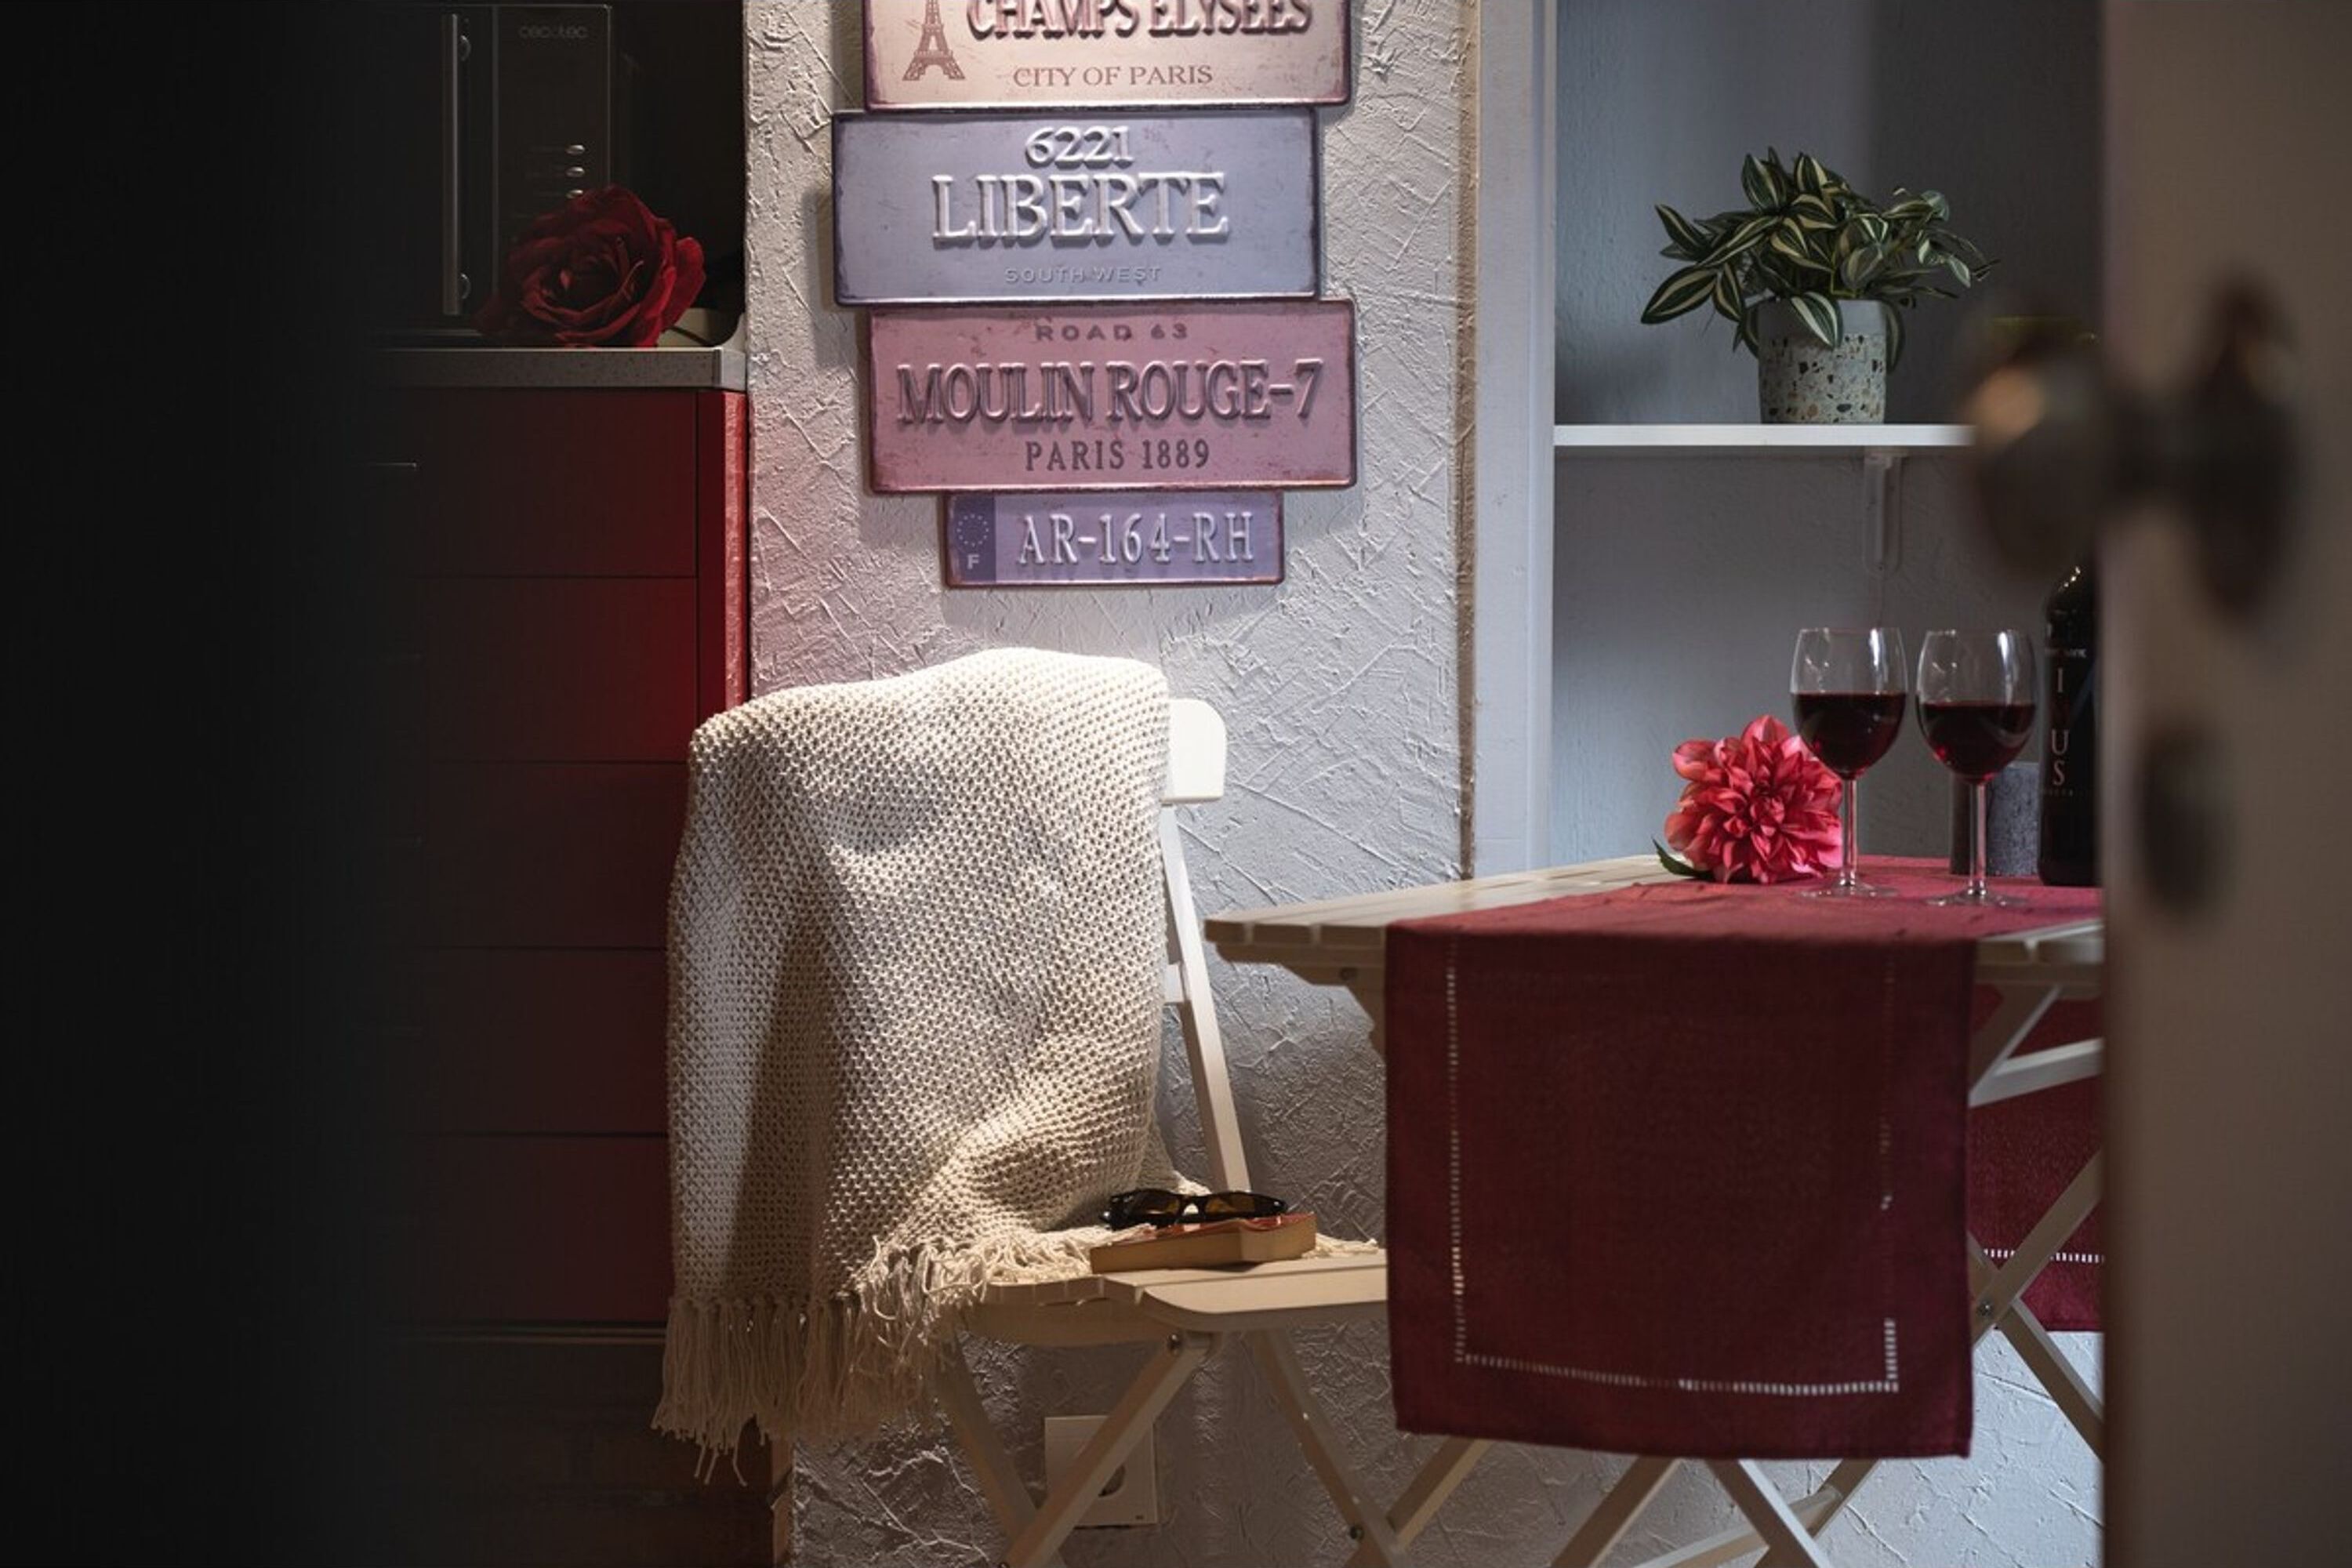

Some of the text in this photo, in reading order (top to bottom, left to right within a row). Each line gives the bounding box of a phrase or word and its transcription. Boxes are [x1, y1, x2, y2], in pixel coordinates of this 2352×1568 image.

[967, 0, 1313, 39] CHAMPS ELYSEES
[1013, 64, 1213, 87] CITY OF PARIS
[1024, 125, 1134, 166] 6221
[931, 172, 1229, 244] LIBERTE
[1005, 266, 1163, 283] SOUTH WEST
[1036, 324, 1132, 340] ROAD
[895, 357, 1324, 424] MOULIN ROUGE-7
[1025, 438, 1210, 470] PARIS 1889
[1020, 511, 1254, 565] AR-164-RH
[967, 554, 980, 570] F
